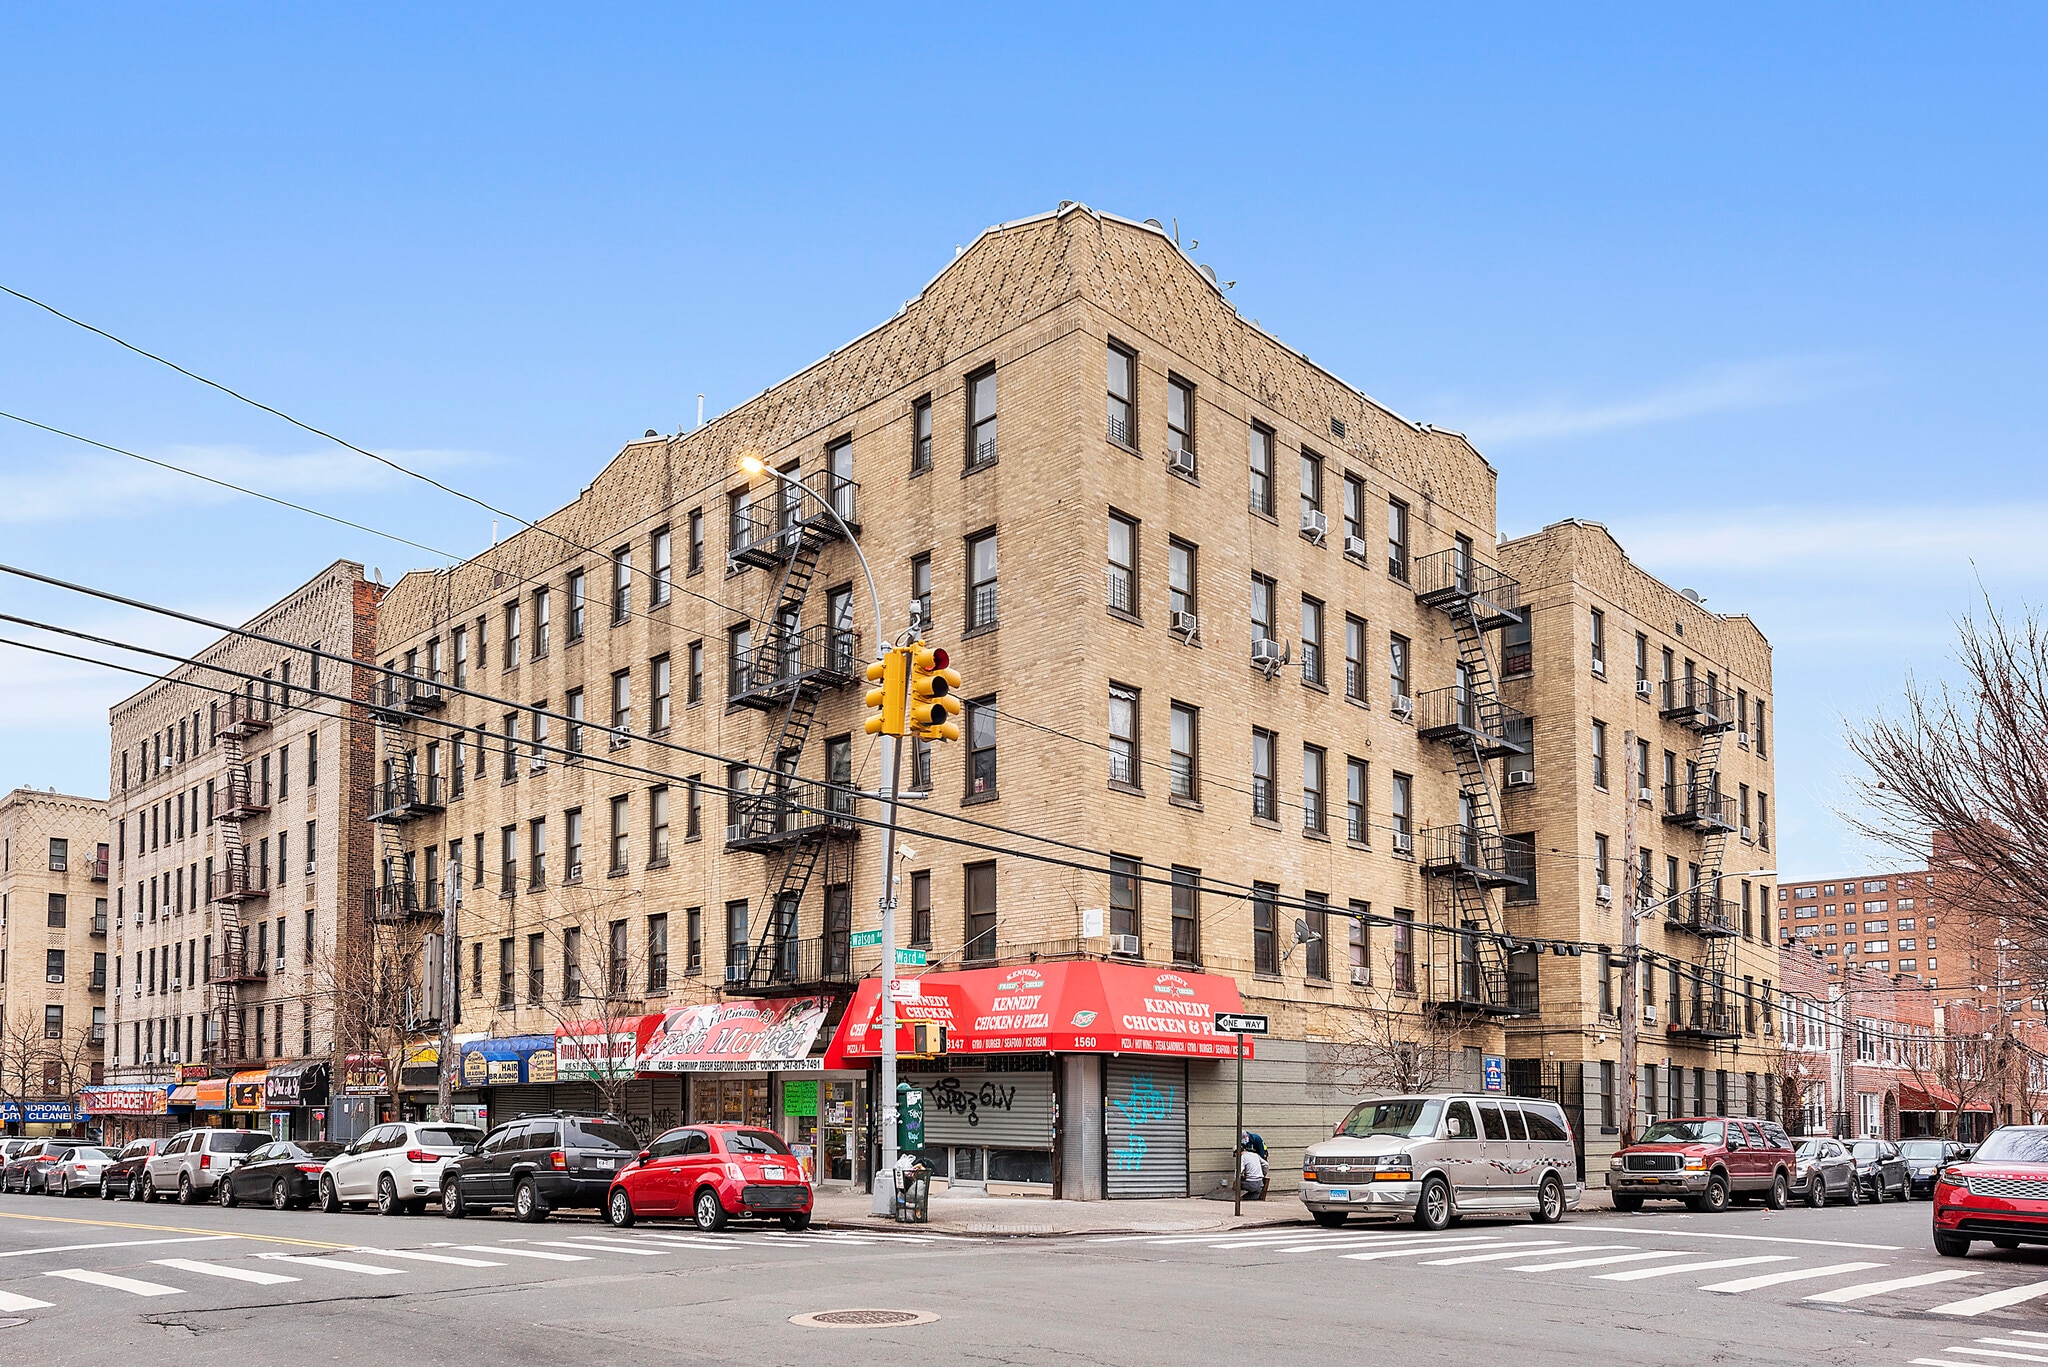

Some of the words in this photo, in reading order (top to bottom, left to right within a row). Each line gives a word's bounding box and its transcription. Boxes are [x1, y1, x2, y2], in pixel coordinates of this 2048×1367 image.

[852, 933, 875, 946] Watson
[896, 950, 916, 963] Ward
[1006, 968, 1041, 982] KENNEDY
[1156, 973, 1188, 987] KENNEDY
[992, 995, 1041, 1011] KENNEDY
[1143, 998, 1210, 1017] KENNEDY
[724, 1006, 759, 1021] Paisano
[906, 1007, 954, 1019] CHICKEN
[974, 1015, 1014, 1031] CHICKEN
[1014, 1014, 1022, 1029] &
[1022, 1013, 1049, 1028] PIZZA
[1122, 1015, 1187, 1034] CHICKEN
[1188, 1020, 1199, 1034] &
[1223, 1019, 1238, 1027] ONE
[1245, 1020, 1262, 1028] WAY
[651, 1028, 708, 1055] Fish
[708, 1022, 808, 1056] Market
[985, 1038, 1001, 1049] BURGER
[1004, 1037, 1022, 1048] SEAFOOD
[1074, 1037, 1096, 1047] 1560
[658, 1061, 673, 1070] CRAB
[677, 1061, 698, 1070] SHRIMP
[699, 1061, 713, 1071] FRESH
[713, 1061, 733, 1071] SEAFOOD
[734, 1061, 757, 1071] LOBSTER
[761, 1061, 778, 1070] CONCH
[95, 1092, 111, 1108] DELI
